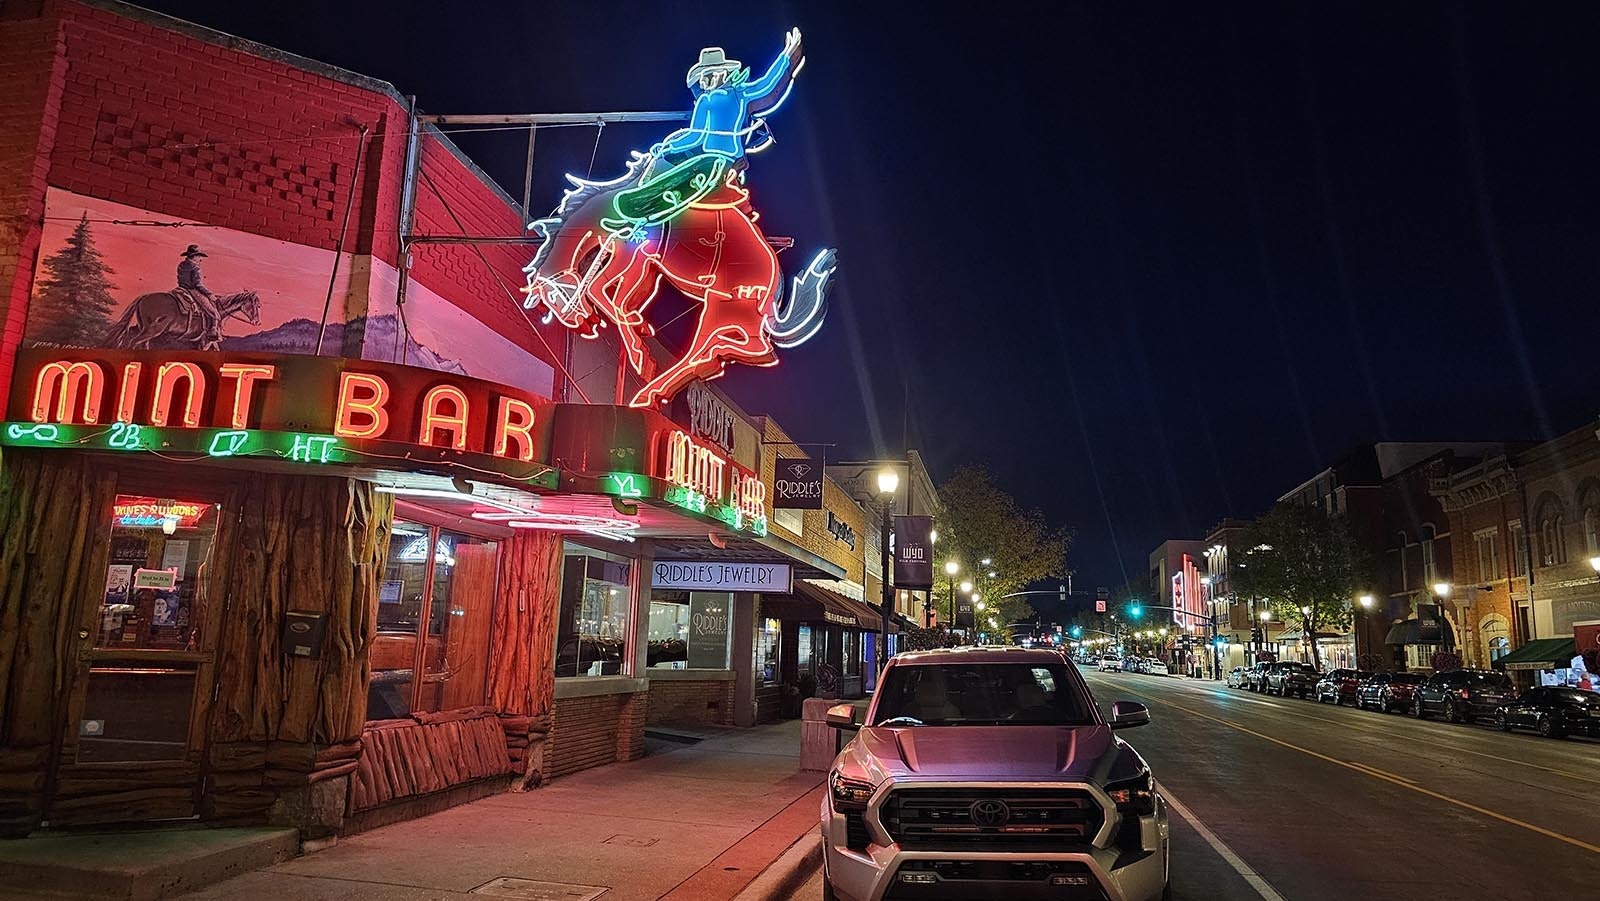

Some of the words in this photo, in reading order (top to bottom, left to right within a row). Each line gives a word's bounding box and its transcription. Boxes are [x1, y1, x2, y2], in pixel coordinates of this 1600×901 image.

[32, 360, 275, 430] MINT
[334, 371, 536, 462] BAR
[651, 430, 726, 504] MINT
[730, 465, 766, 521] BAR
[776, 479, 821, 499] RIDDLE'S
[903, 547, 923, 560] WYO
[655, 563, 713, 585] RIDDLE'S
[716, 565, 775, 585] JEWELRY
[693, 612, 727, 636] RIDDLE'S
